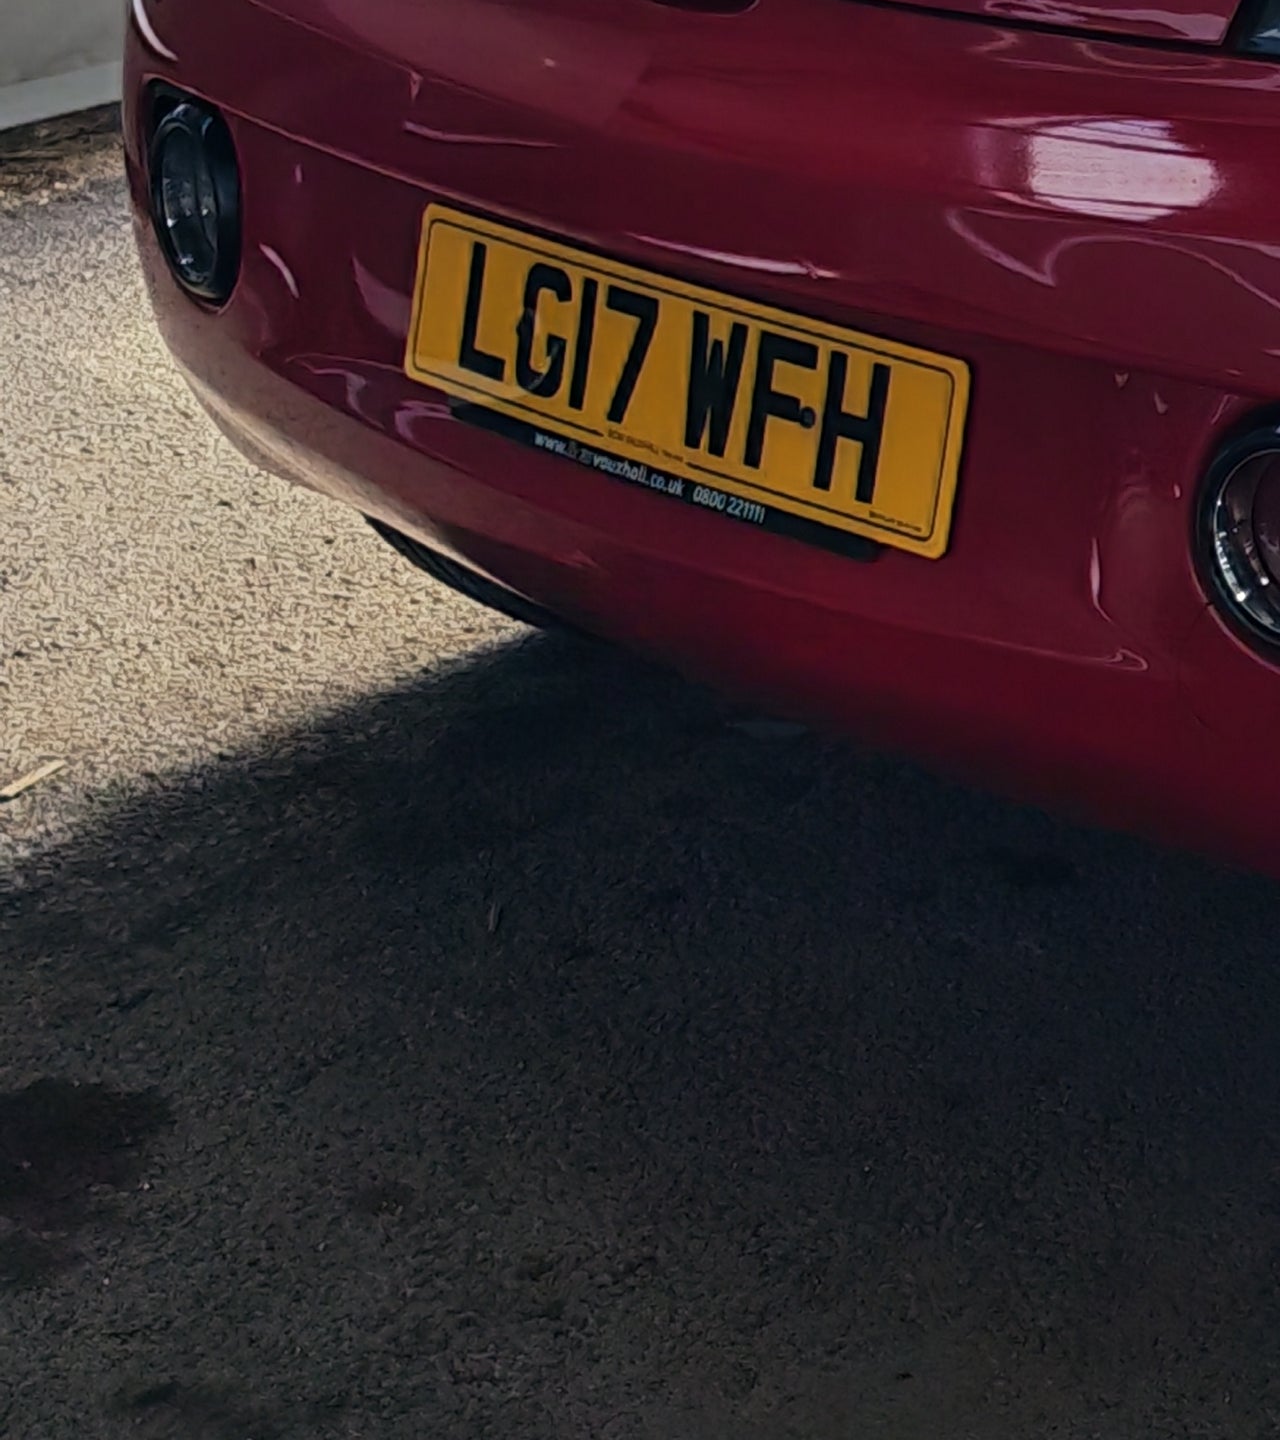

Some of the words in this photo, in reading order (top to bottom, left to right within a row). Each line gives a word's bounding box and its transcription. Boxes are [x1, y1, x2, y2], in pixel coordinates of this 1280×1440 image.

[457, 241, 660, 425] LG17
[684, 309, 892, 506] WFH
[692, 486, 726, 512] 0800
